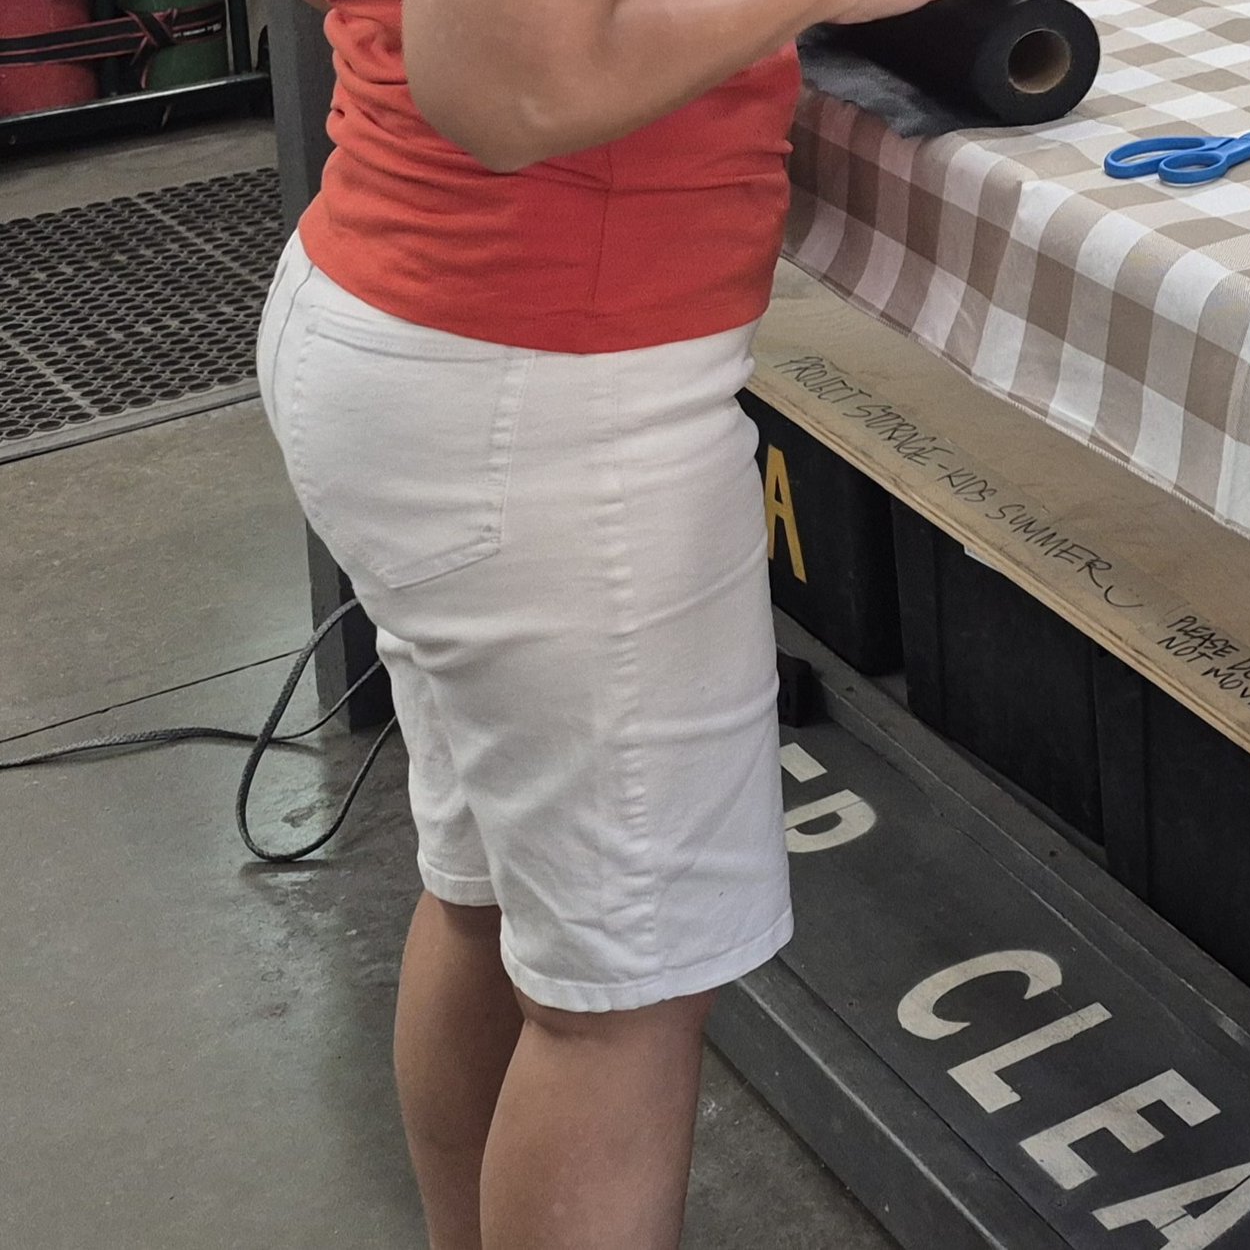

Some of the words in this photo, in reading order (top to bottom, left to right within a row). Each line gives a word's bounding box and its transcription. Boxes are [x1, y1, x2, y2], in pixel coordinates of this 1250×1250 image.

[773, 355, 873, 404] PROJECT
[842, 404, 954, 467] STORAGE
[984, 503, 1113, 589] SUMMER
[1156, 636, 1214, 663] NOT
[1166, 615, 1241, 658] PLEASE
